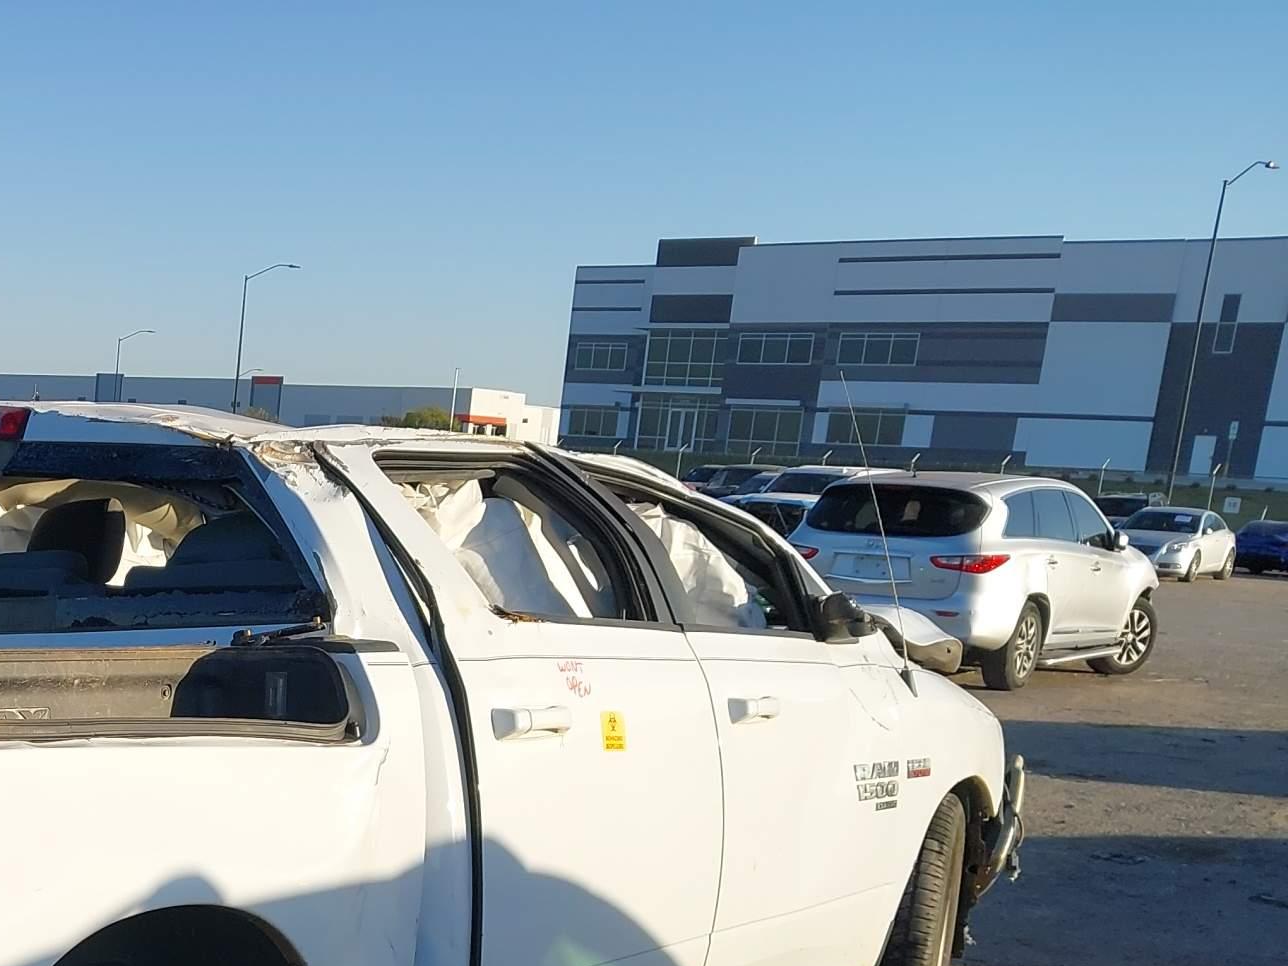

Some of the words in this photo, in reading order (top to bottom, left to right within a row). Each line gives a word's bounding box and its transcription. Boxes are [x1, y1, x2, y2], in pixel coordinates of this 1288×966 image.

[566, 675, 591, 698] OPEN
[853, 760, 899, 782] RAM
[856, 780, 899, 802] 1500
